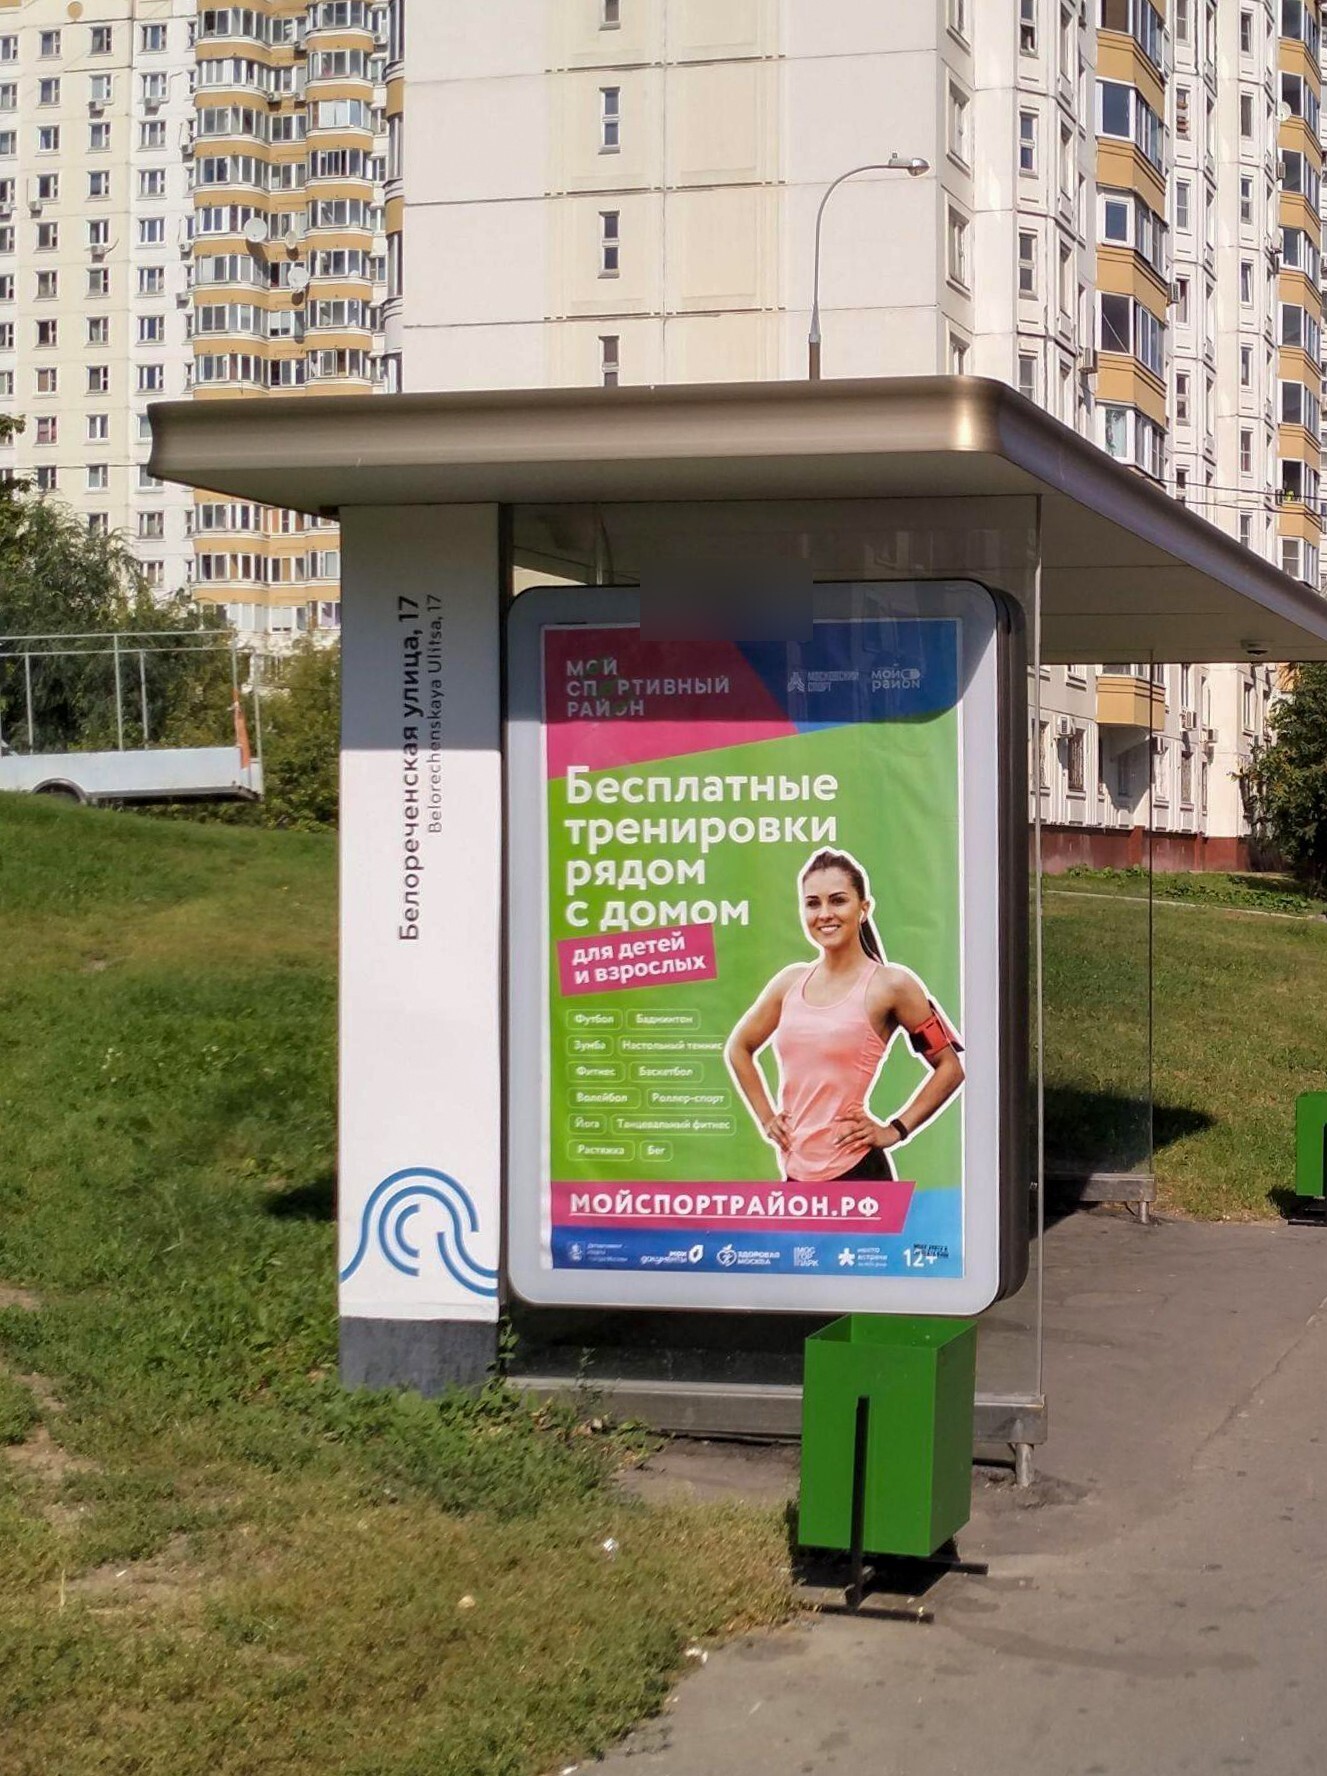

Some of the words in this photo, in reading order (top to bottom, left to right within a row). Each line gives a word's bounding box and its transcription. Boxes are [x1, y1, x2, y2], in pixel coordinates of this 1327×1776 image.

[398, 595, 419, 623] 17
[426, 594, 442, 612] 17
[426, 616, 443, 674] Ulitsa,
[402, 630, 424, 718] улица,
[566, 675, 730, 697] СПРТИВНЫЙ
[426, 680, 445, 833] Belorechenskaya
[566, 765, 838, 804] Бесплатные
[399, 726, 424, 941] Белореченская
[564, 816, 837, 854] тренировки
[566, 859, 706, 896] рядом
[566, 900, 589, 927] с
[600, 900, 749, 932] домом
[572, 945, 613, 966] для
[618, 931, 685, 960] детей
[575, 970, 590, 985] и
[595, 955, 706, 984] взрослых
[574, 1013, 614, 1026] Футбол
[636, 1013, 693, 1025] Бадминтон
[574, 1040, 606, 1052] Зумба
[622, 1040, 685, 1050] Настольный
[687, 1041, 723, 1050] теннис
[575, 1066, 616, 1077] Фитнес
[639, 1066, 693, 1076] Баскетбол
[576, 1092, 628, 1103] Волейбол
[652, 1092, 725, 1104] Роллер-спорт
[575, 1117, 600, 1128] Йога
[616, 1118, 690, 1130] Танцевальный
[692, 1119, 730, 1131] фитнес
[578, 1144, 625, 1155] Растяжка
[647, 1145, 666, 1155] Бег
[569, 1189, 880, 1217] МОЙСПОРТРАЙОН.РФ
